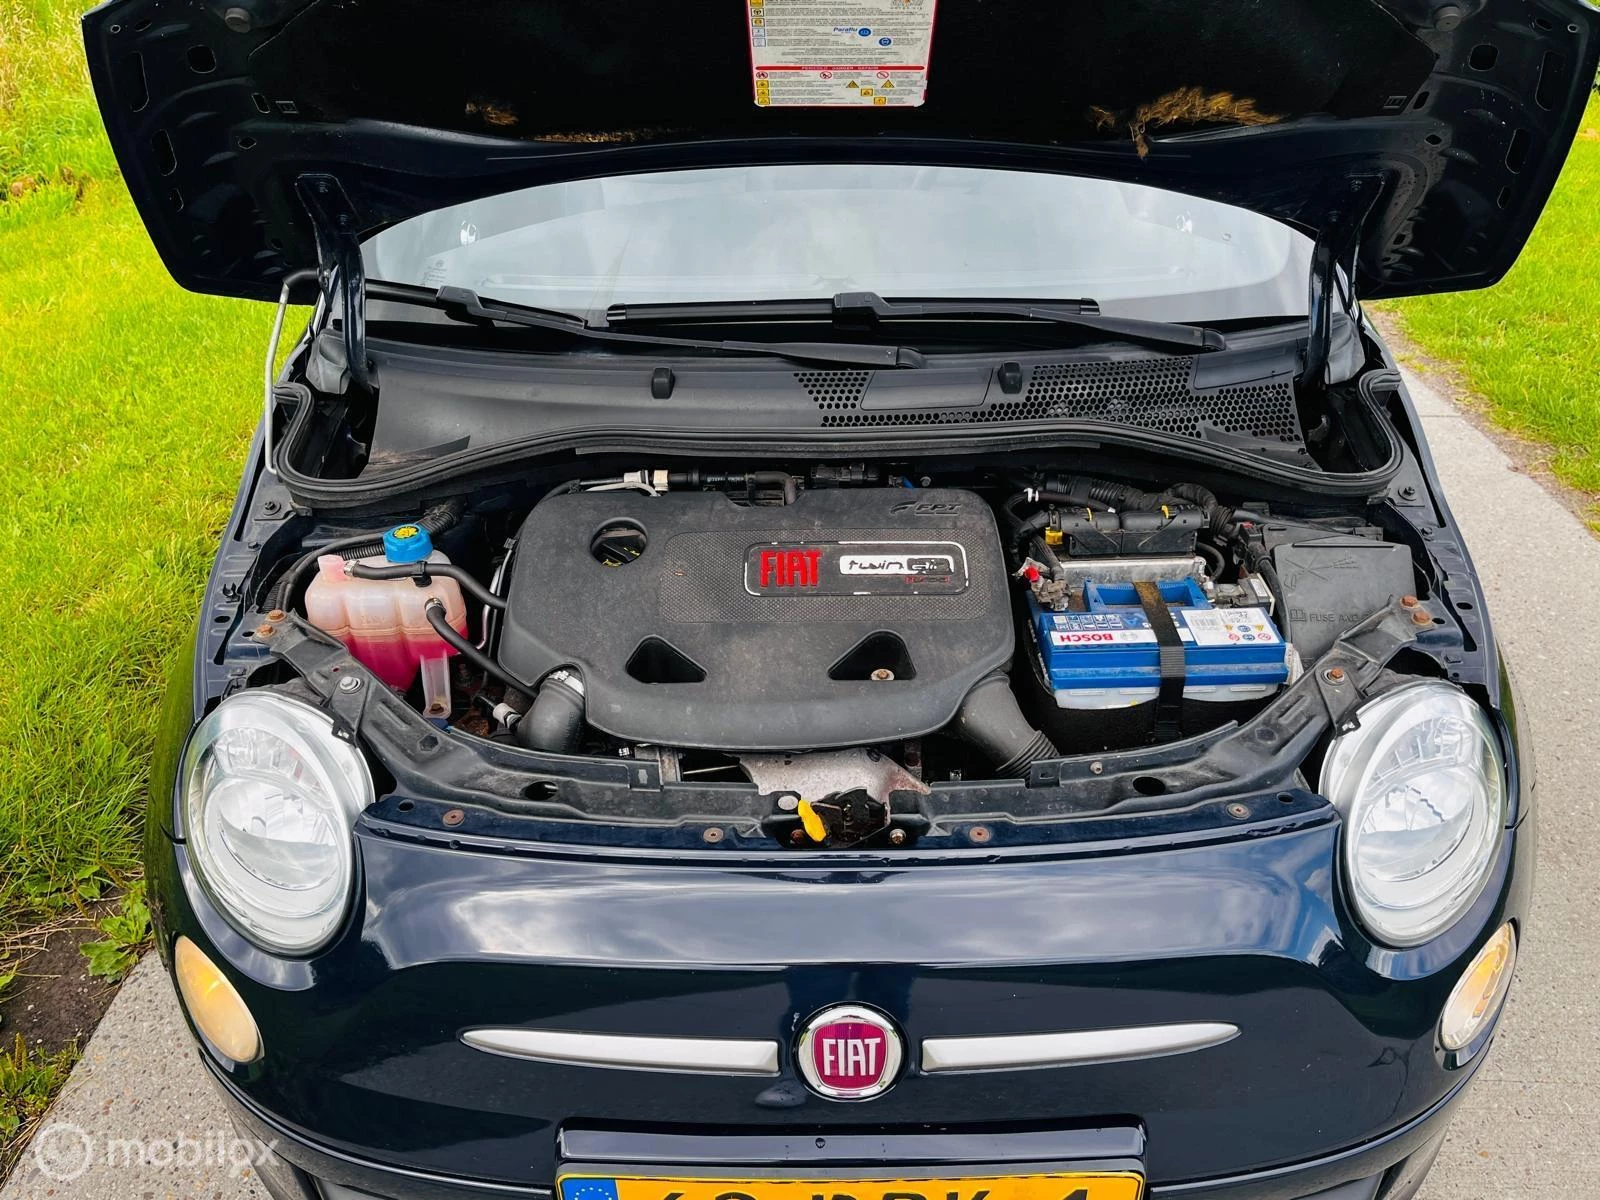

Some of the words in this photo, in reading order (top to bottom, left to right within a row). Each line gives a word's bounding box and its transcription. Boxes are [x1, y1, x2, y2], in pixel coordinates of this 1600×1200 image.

[759, 548, 823, 587] FIAT
[1309, 613, 1336, 623] FUSE
[1060, 632, 1114, 643] BOSCH
[822, 1037, 882, 1077] FIAT
